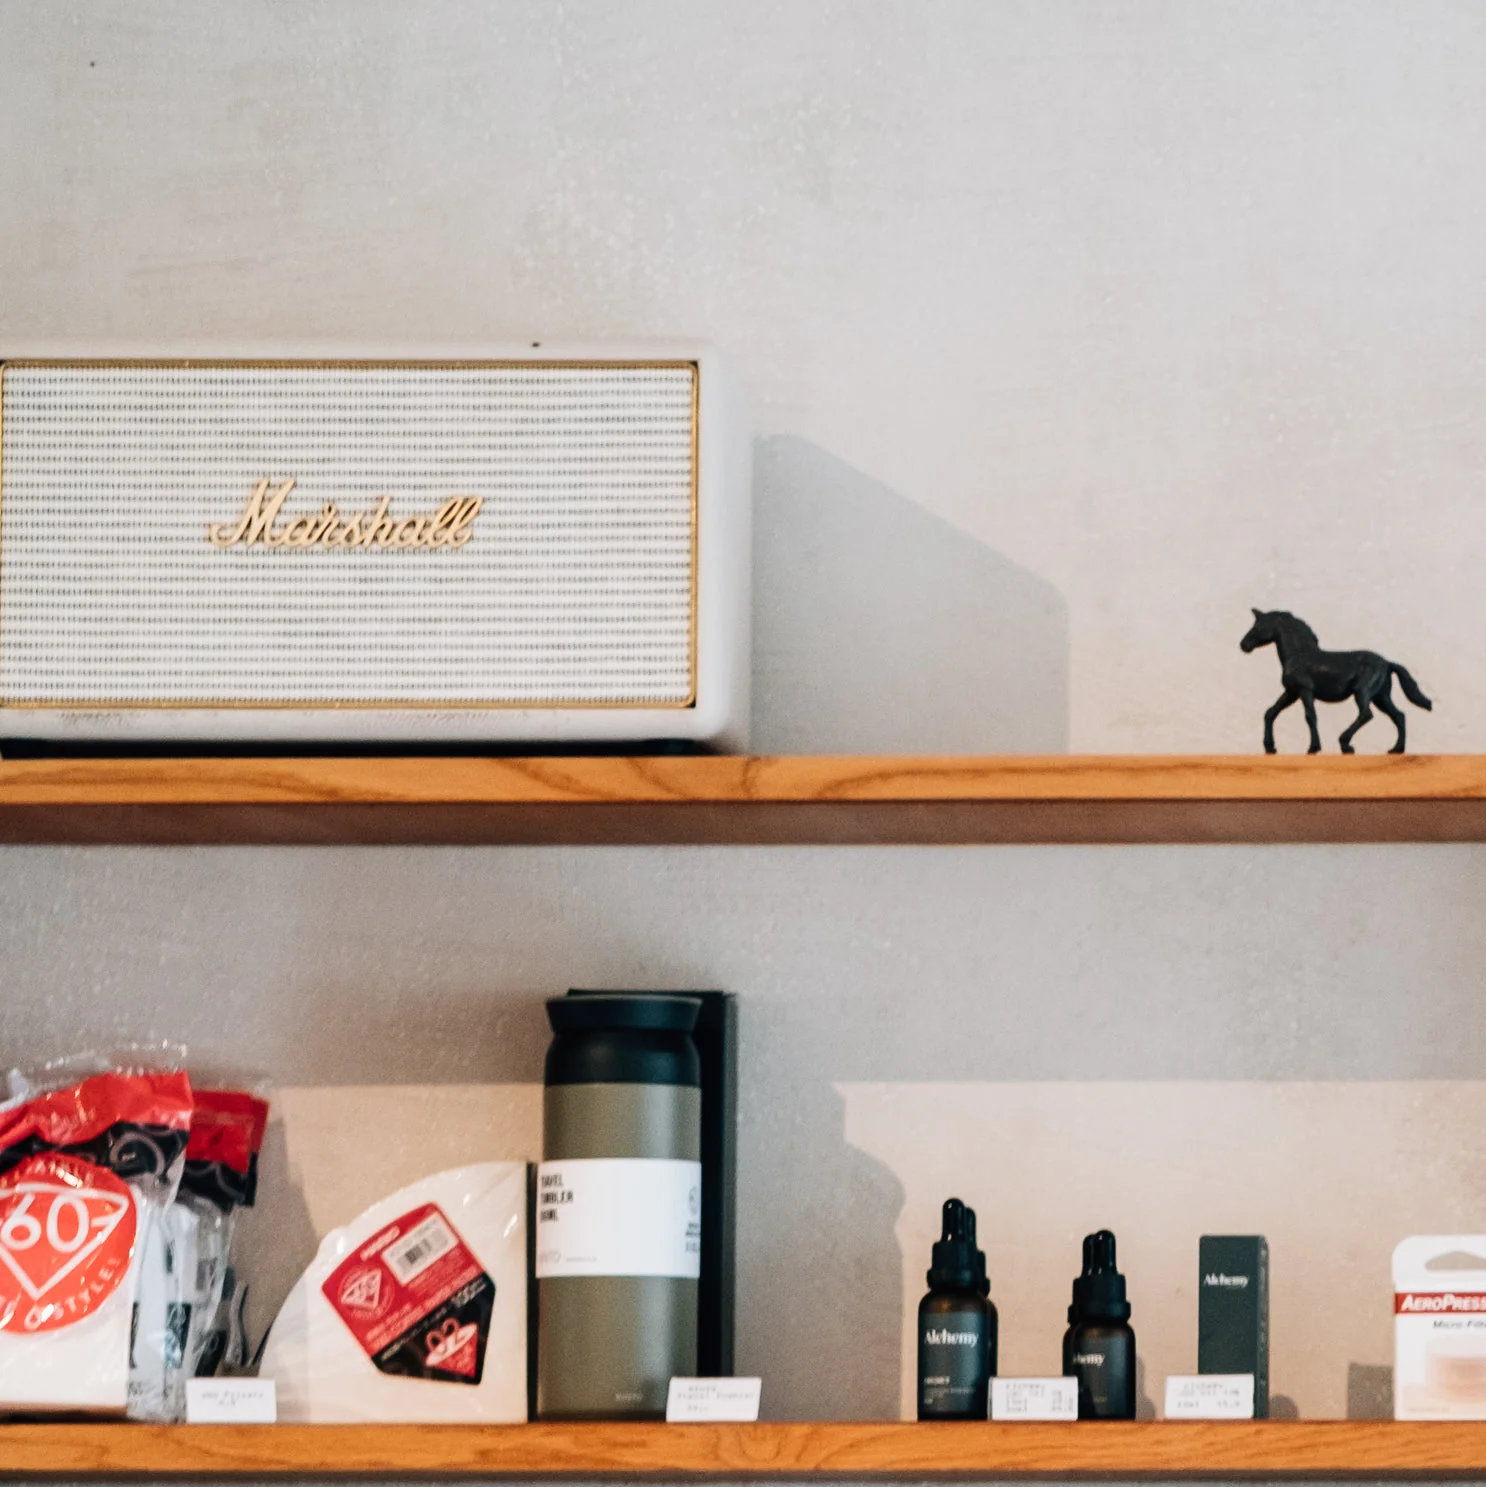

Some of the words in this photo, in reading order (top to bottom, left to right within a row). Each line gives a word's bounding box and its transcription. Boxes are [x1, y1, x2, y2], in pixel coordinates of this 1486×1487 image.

[210, 478, 484, 548] Marshall
[1203, 1273, 1249, 1289] Alchemy
[1433, 1320, 1462, 1329] Micro
[924, 1328, 979, 1348] Alchemy
